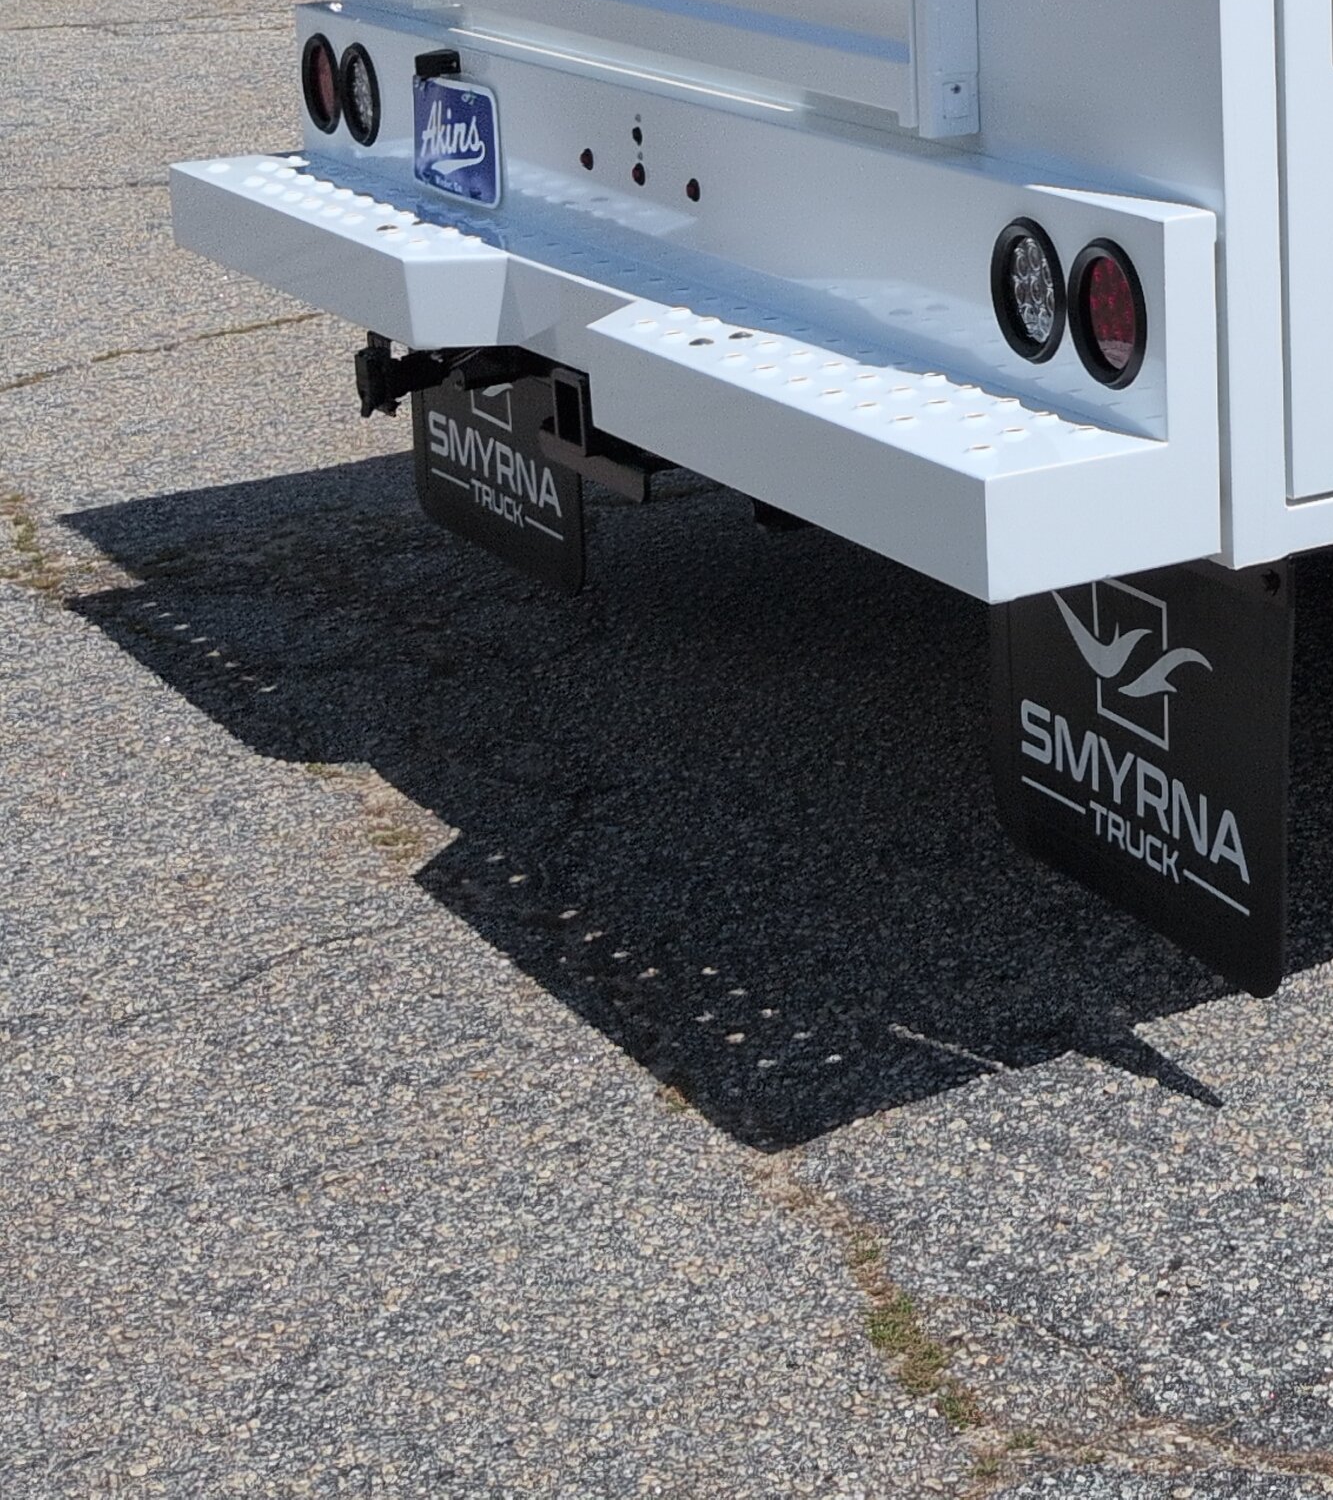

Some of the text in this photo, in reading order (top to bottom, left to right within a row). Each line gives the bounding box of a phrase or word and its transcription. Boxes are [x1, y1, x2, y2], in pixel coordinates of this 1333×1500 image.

[420, 100, 485, 175] Akins
[428, 410, 563, 518] SMYRNA
[471, 478, 525, 528] TRUCK
[1021, 698, 1251, 885] SMYRNA
[1089, 800, 1181, 884] TRUCK
